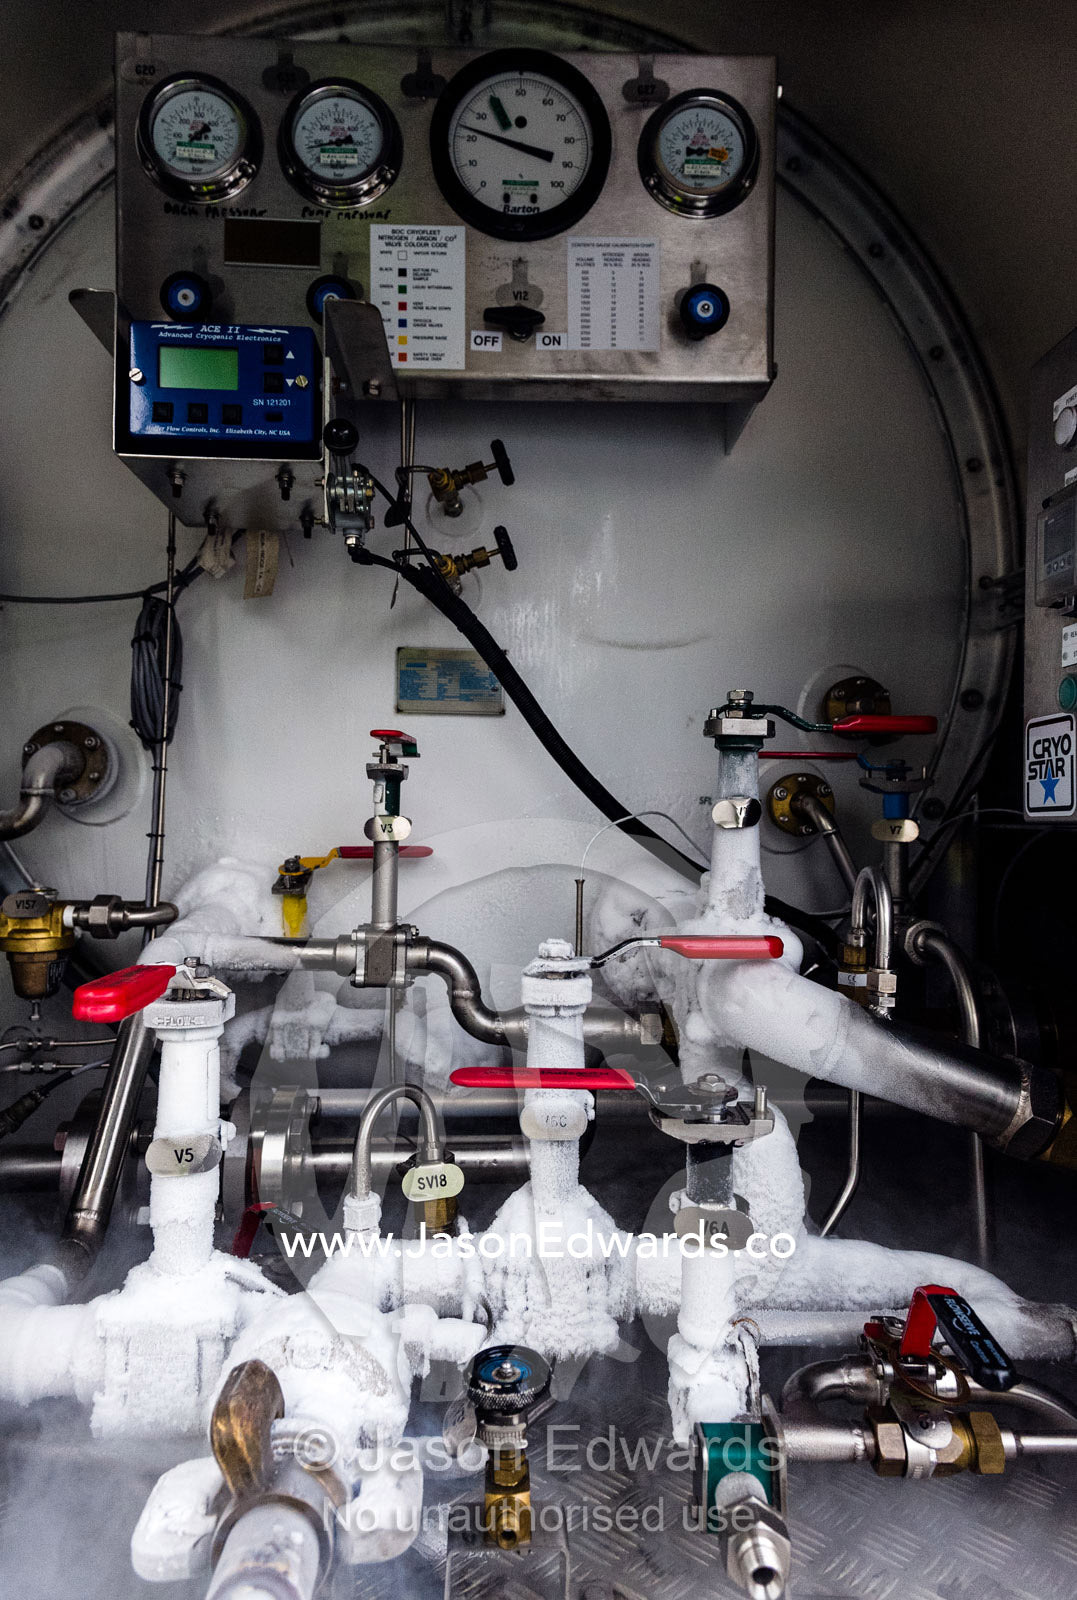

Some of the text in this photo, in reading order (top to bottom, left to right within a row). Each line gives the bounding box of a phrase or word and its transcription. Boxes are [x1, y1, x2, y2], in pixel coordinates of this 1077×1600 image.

[550, 180, 564, 188] 100
[503, 204, 540, 214] Barton
[512, 290, 529, 301] V12
[200, 325, 241, 334] ACE II
[158, 331, 282, 342] Advanced Cryogenic Electronics
[473, 334, 499, 347] OFF
[542, 334, 561, 347] ON
[166, 425, 180, 433] Flow
[225, 427, 253, 435] Elizabeth
[1032, 733, 1072, 759] CRYO
[1028, 757, 1066, 780] STAR
[380, 823, 393, 833] V3
[889, 825, 901, 836] V7
[15, 900, 36, 910] V157
[174, 1148, 194, 1164] V5
[417, 1174, 447, 1190] SV18
